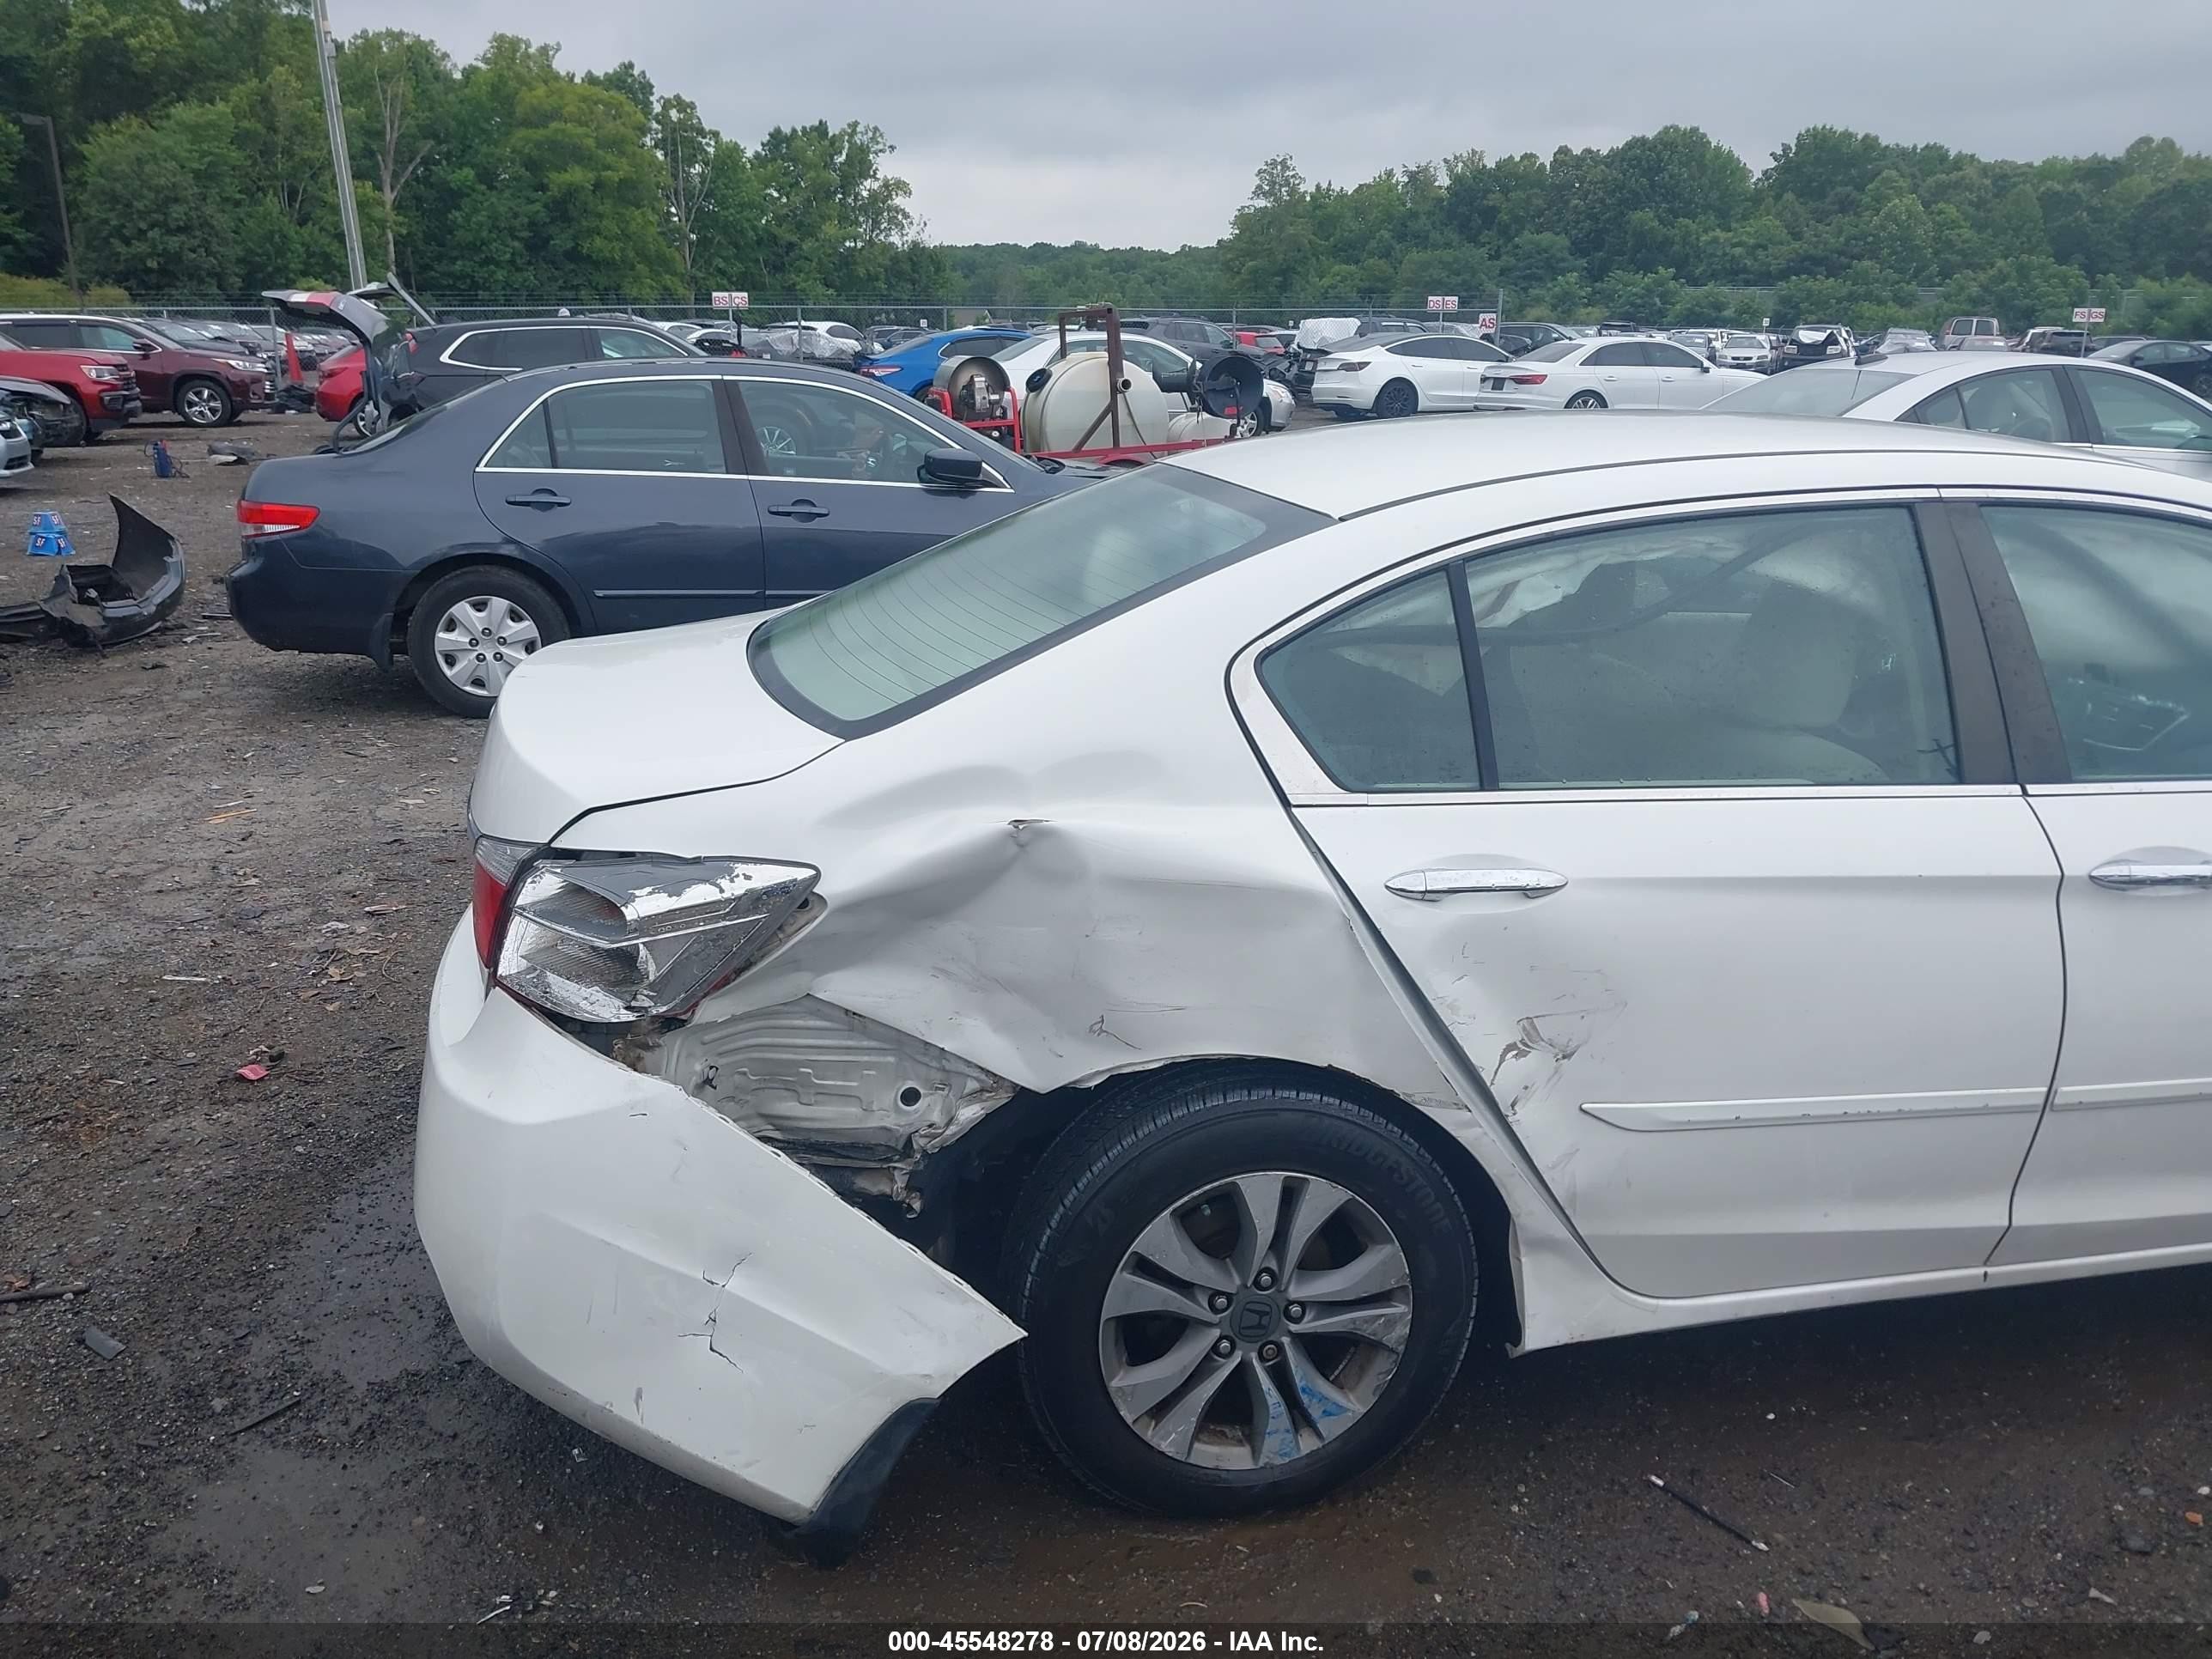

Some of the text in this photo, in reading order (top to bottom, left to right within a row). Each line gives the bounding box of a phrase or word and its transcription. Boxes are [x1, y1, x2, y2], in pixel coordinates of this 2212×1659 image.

[714, 296, 747, 306] BS CS
[1428, 300, 1457, 309] DS ES
[1480, 318, 1496, 329] AS
[35, 538, 46, 547] SF
